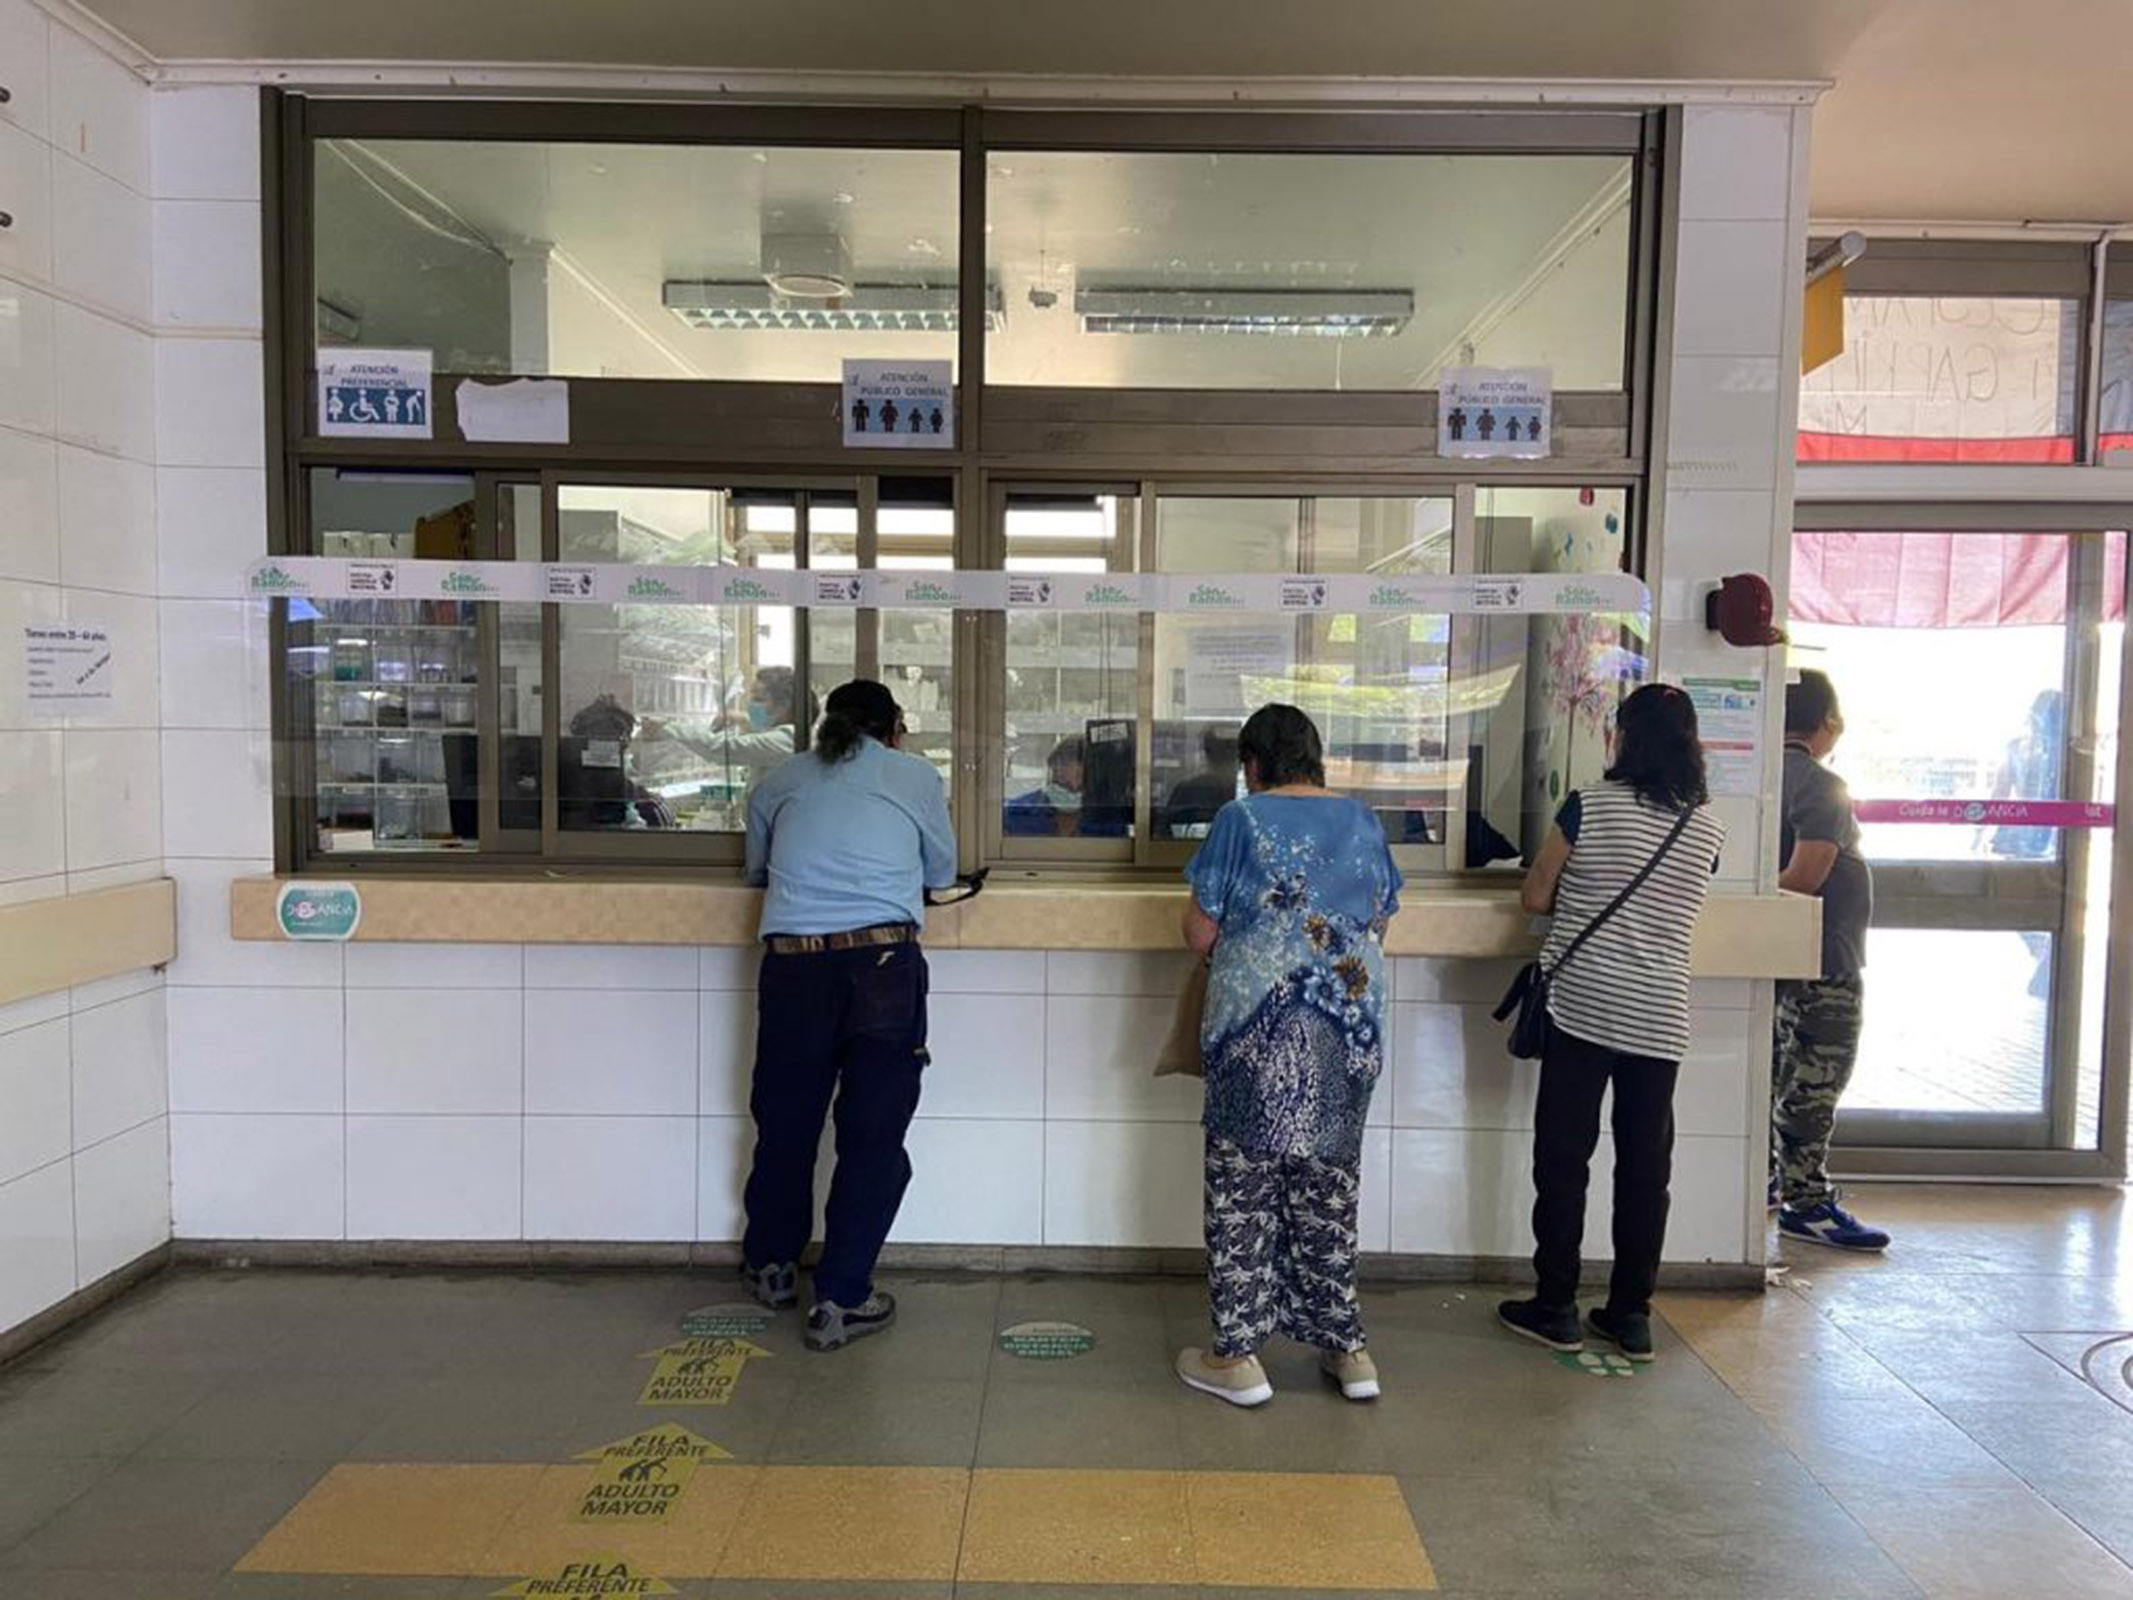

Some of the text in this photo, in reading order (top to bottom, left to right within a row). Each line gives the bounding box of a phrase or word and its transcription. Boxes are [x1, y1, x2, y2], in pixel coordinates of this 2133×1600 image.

[662, 1347, 751, 1357] PREFERENTE
[651, 1376, 733, 1388] ADULTO
[648, 1388, 724, 1400] MAYOR
[633, 1435, 690, 1447] FILA
[602, 1446, 709, 1458] PREFERENTE
[586, 1484, 681, 1499] ADULTO
[579, 1501, 669, 1516] MAYOR
[559, 1563, 629, 1579] FILA
[526, 1577, 650, 1595] PREFERENTE
